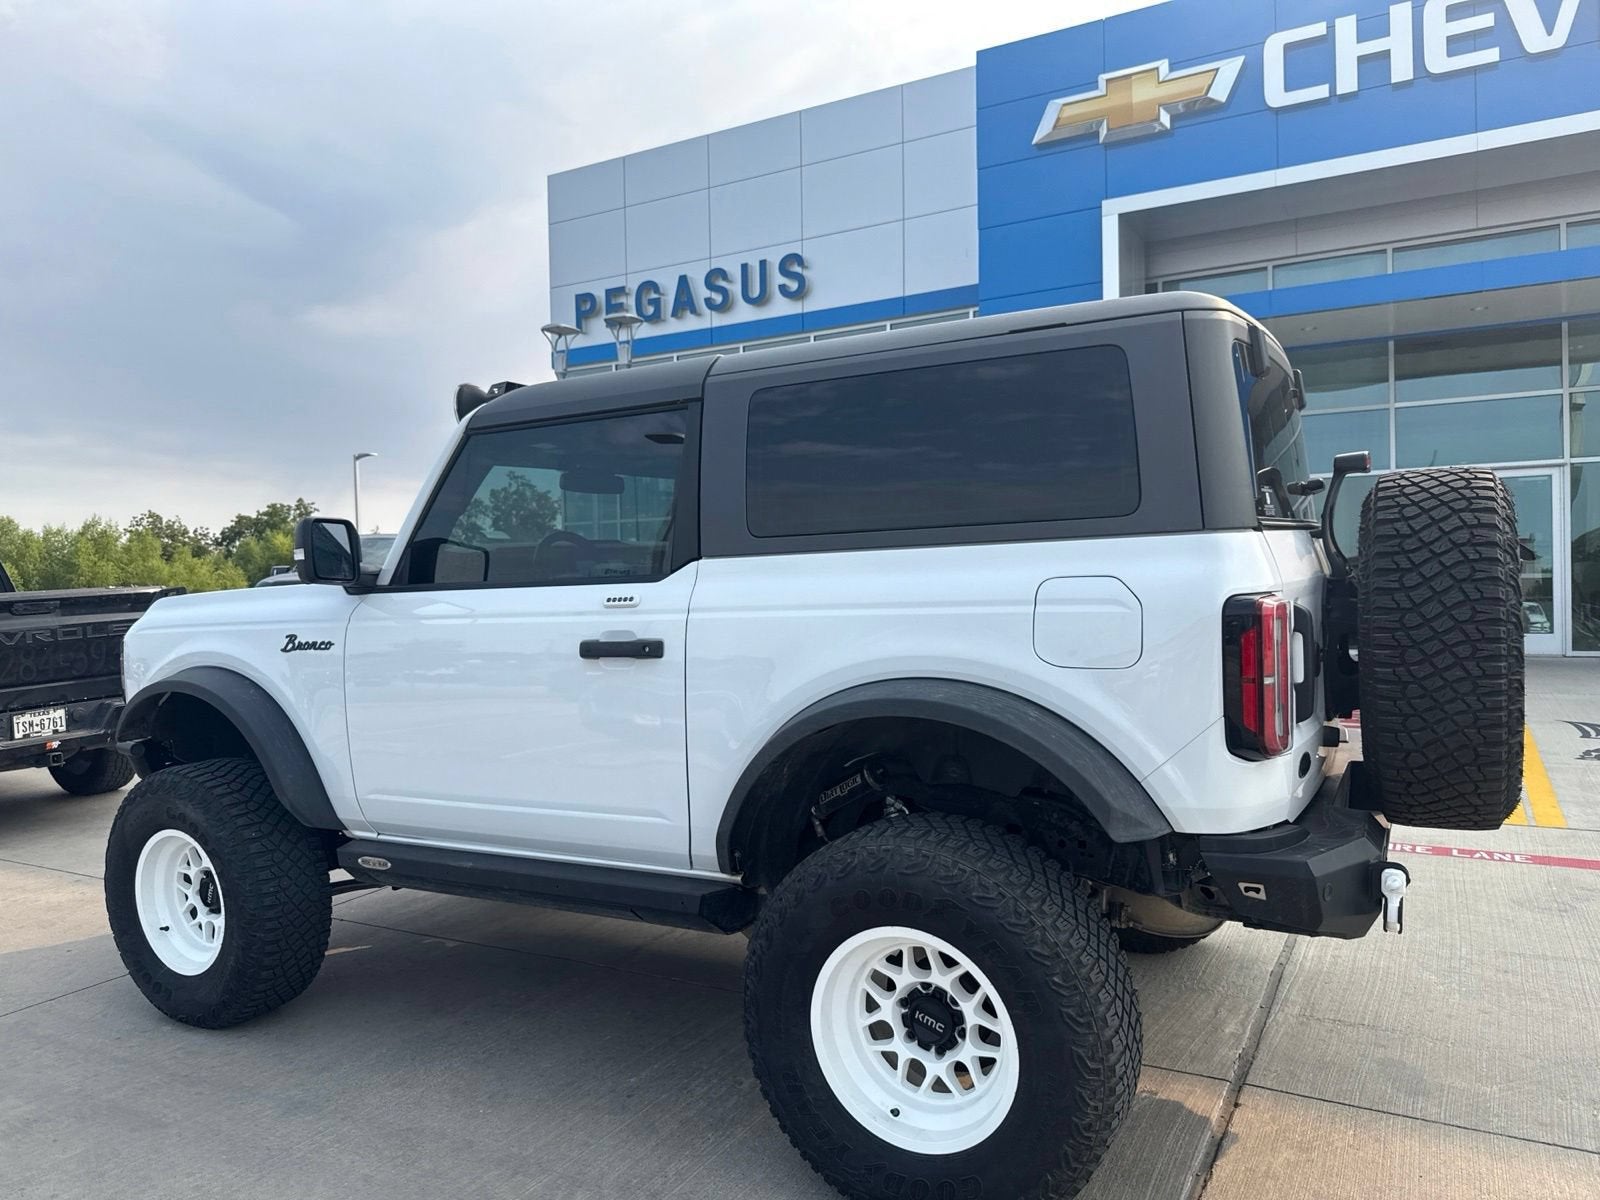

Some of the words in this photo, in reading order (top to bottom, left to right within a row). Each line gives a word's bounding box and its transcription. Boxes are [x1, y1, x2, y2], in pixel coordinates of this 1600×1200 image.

[1263, 0, 1581, 109] CHEV
[574, 252, 807, 334] PEGASUS
[279, 633, 335, 653] Bronco
[28, 710, 51, 718] TEXAS
[1388, 842, 1433, 855] IRE
[1452, 848, 1533, 864] LANE
[914, 1010, 945, 1033] KMC
